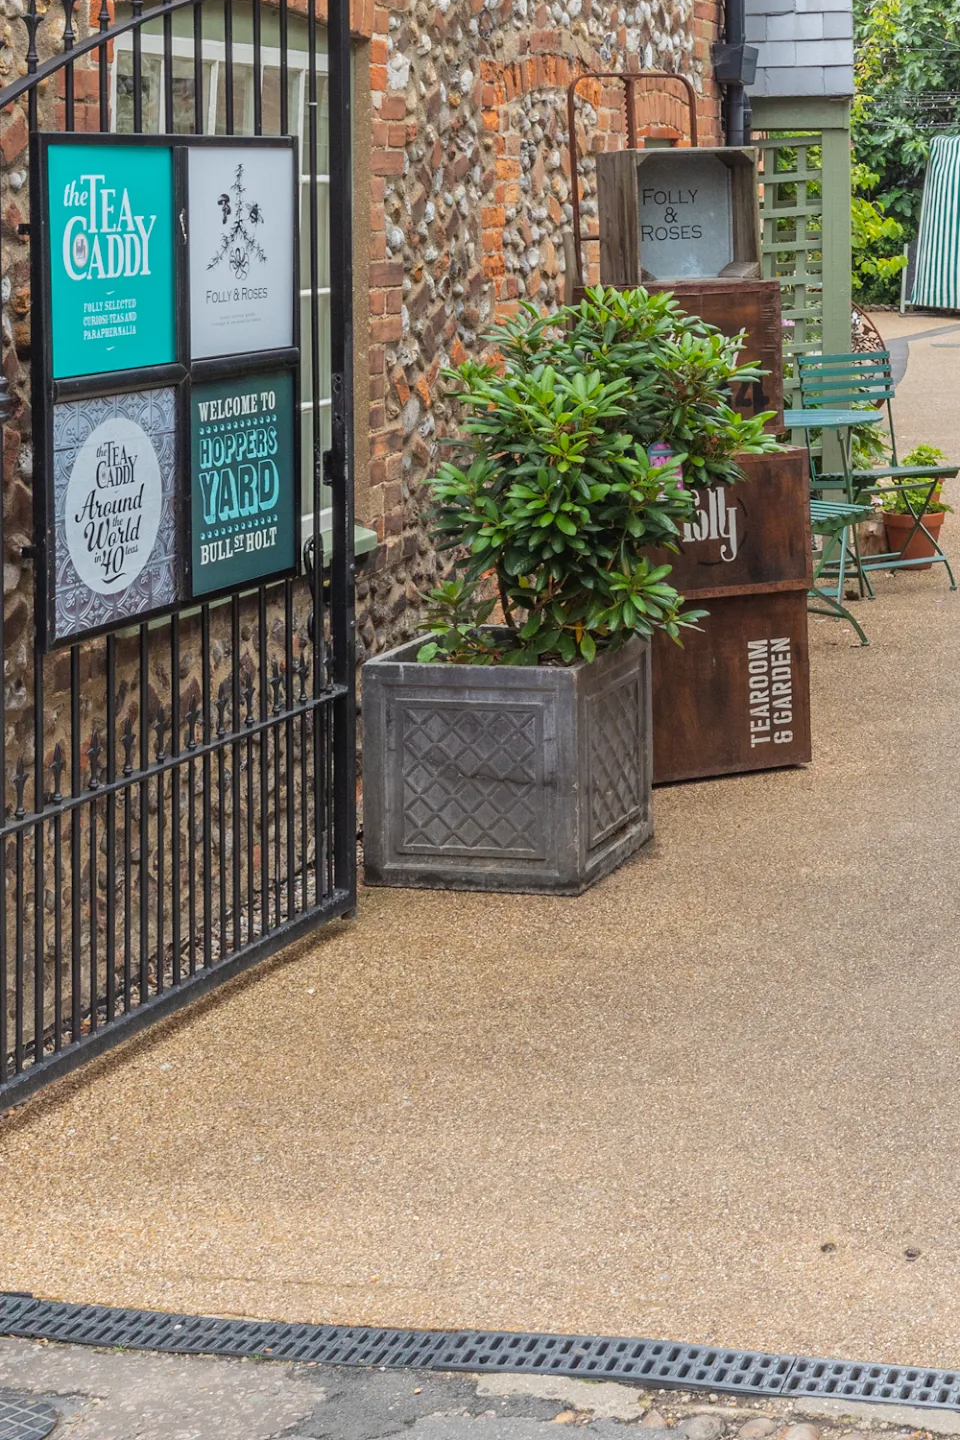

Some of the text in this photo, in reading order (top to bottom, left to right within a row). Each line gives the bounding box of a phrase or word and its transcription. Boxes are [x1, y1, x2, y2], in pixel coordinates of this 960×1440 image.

[63, 174, 135, 233] the TEA
[642, 188, 698, 206] FOLLY
[664, 206, 678, 224] &
[62, 215, 157, 281] CADDY
[641, 225, 702, 242] ROSES
[104, 298, 137, 311] SELECTED
[206, 287, 268, 304] FOLLY & ROSES
[83, 325, 137, 340] PARAPHERNALIA
[198, 391, 276, 422] WELCOME TO
[96, 441, 128, 468] the TEA
[200, 426, 278, 469] HOPPERS
[96, 455, 138, 489] CADDY
[75, 483, 145, 523] Around
[199, 459, 280, 525] YARD
[84, 514, 141, 552] World
[112, 515, 124, 528] the
[94, 544, 139, 576] in 40 teas
[200, 526, 278, 566] BULL ST HOLT
[747, 639, 771, 748] TEAROOM
[770, 637, 794, 744] & GARDEN
